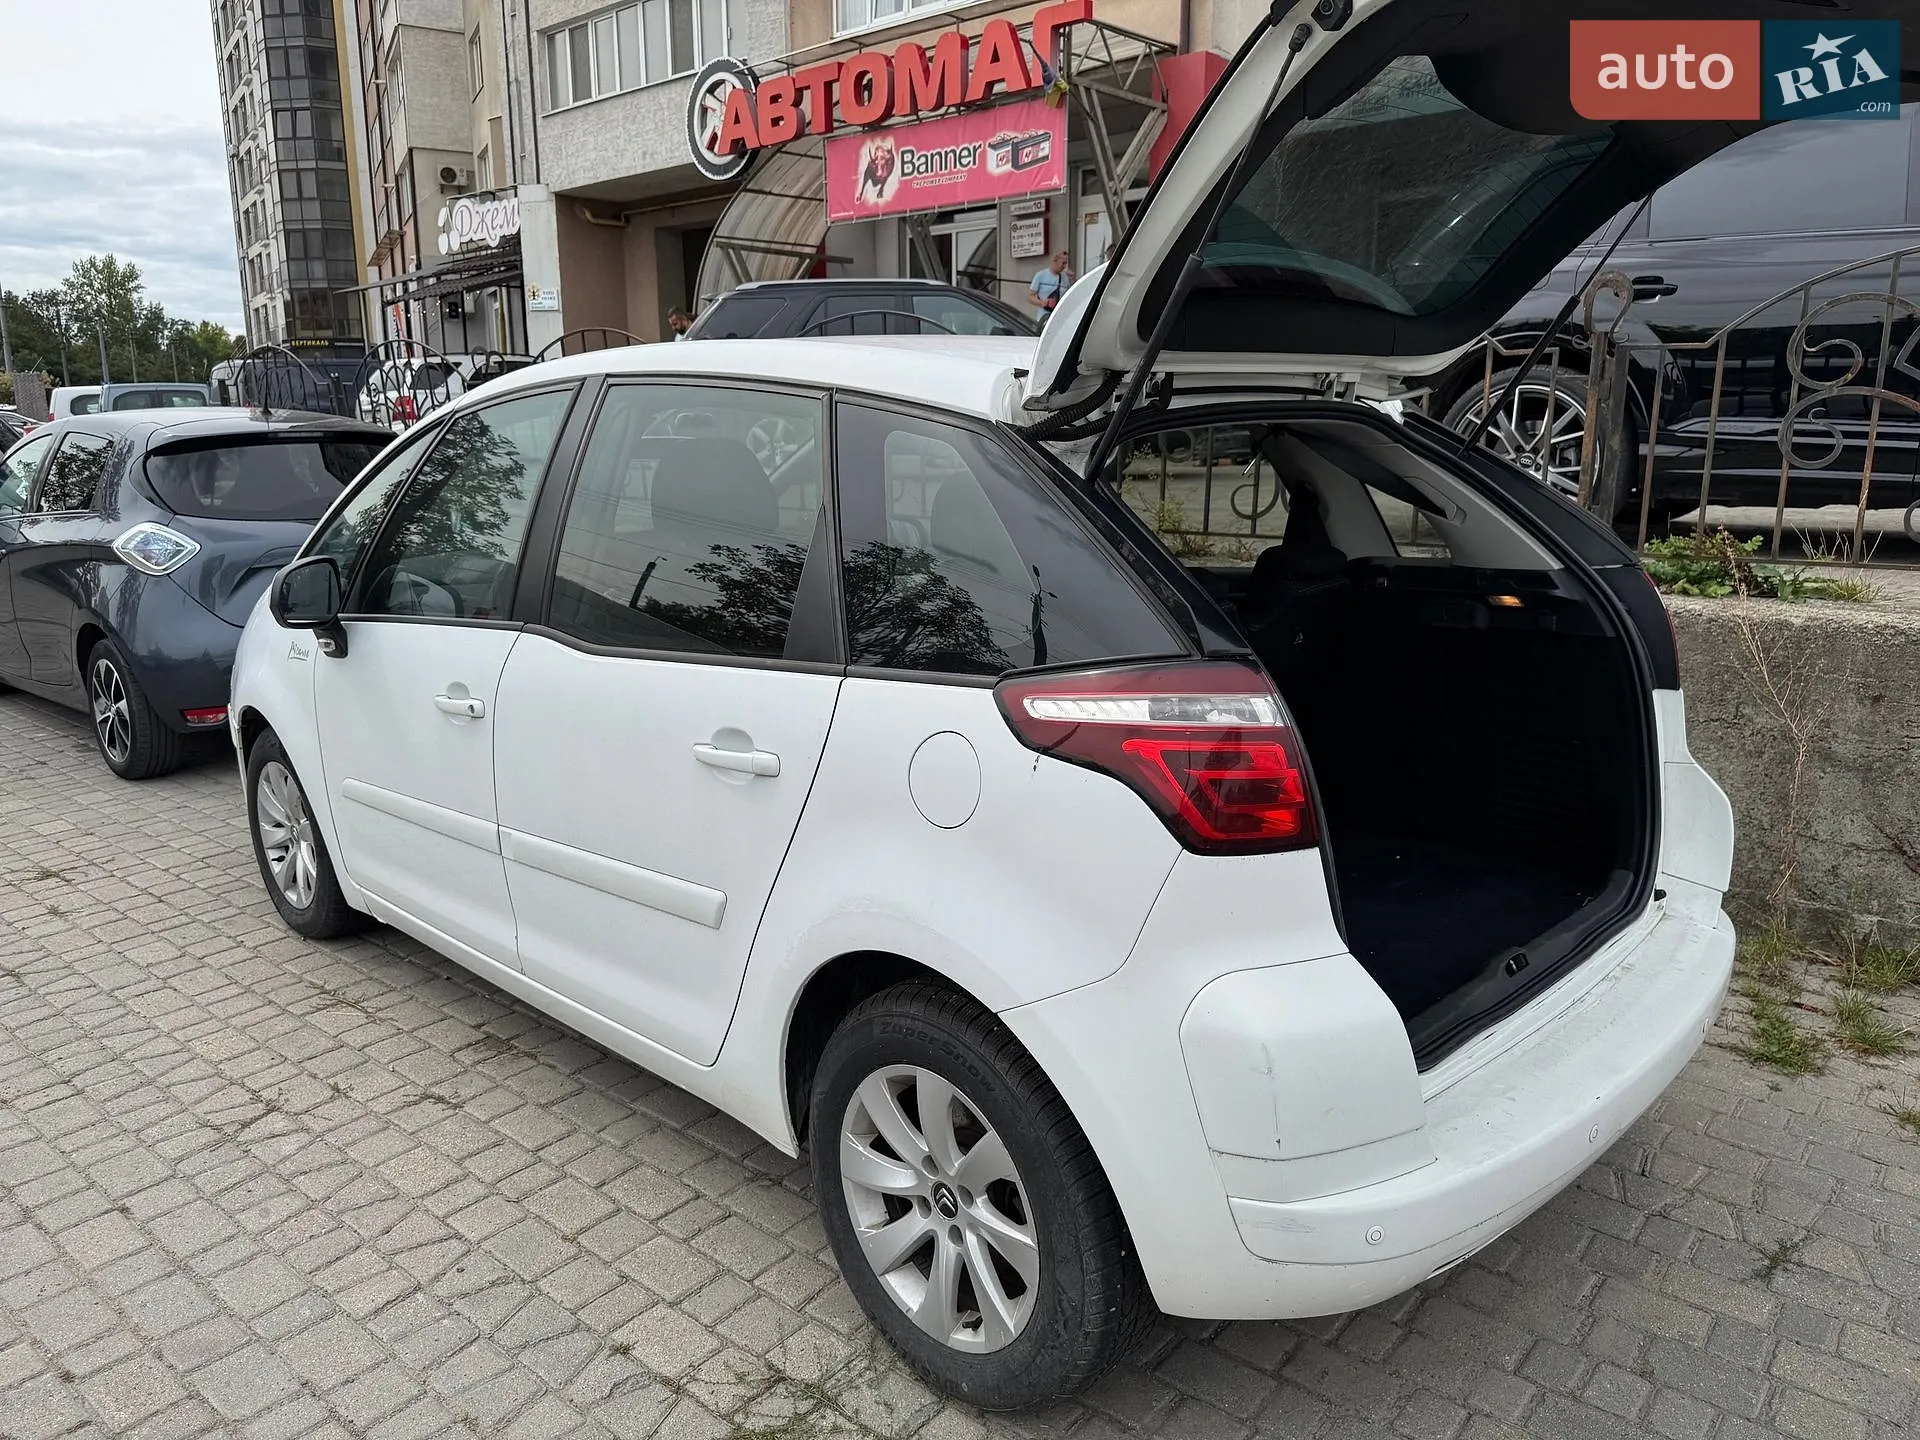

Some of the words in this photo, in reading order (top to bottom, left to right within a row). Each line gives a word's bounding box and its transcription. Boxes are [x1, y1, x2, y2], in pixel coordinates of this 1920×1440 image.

[718, 0, 1093, 156] АВТОМАГ
[900, 142, 983, 178] Banner
[454, 203, 519, 241] Джем
[291, 339, 330, 347] ВЕРТИКАЛЬ
